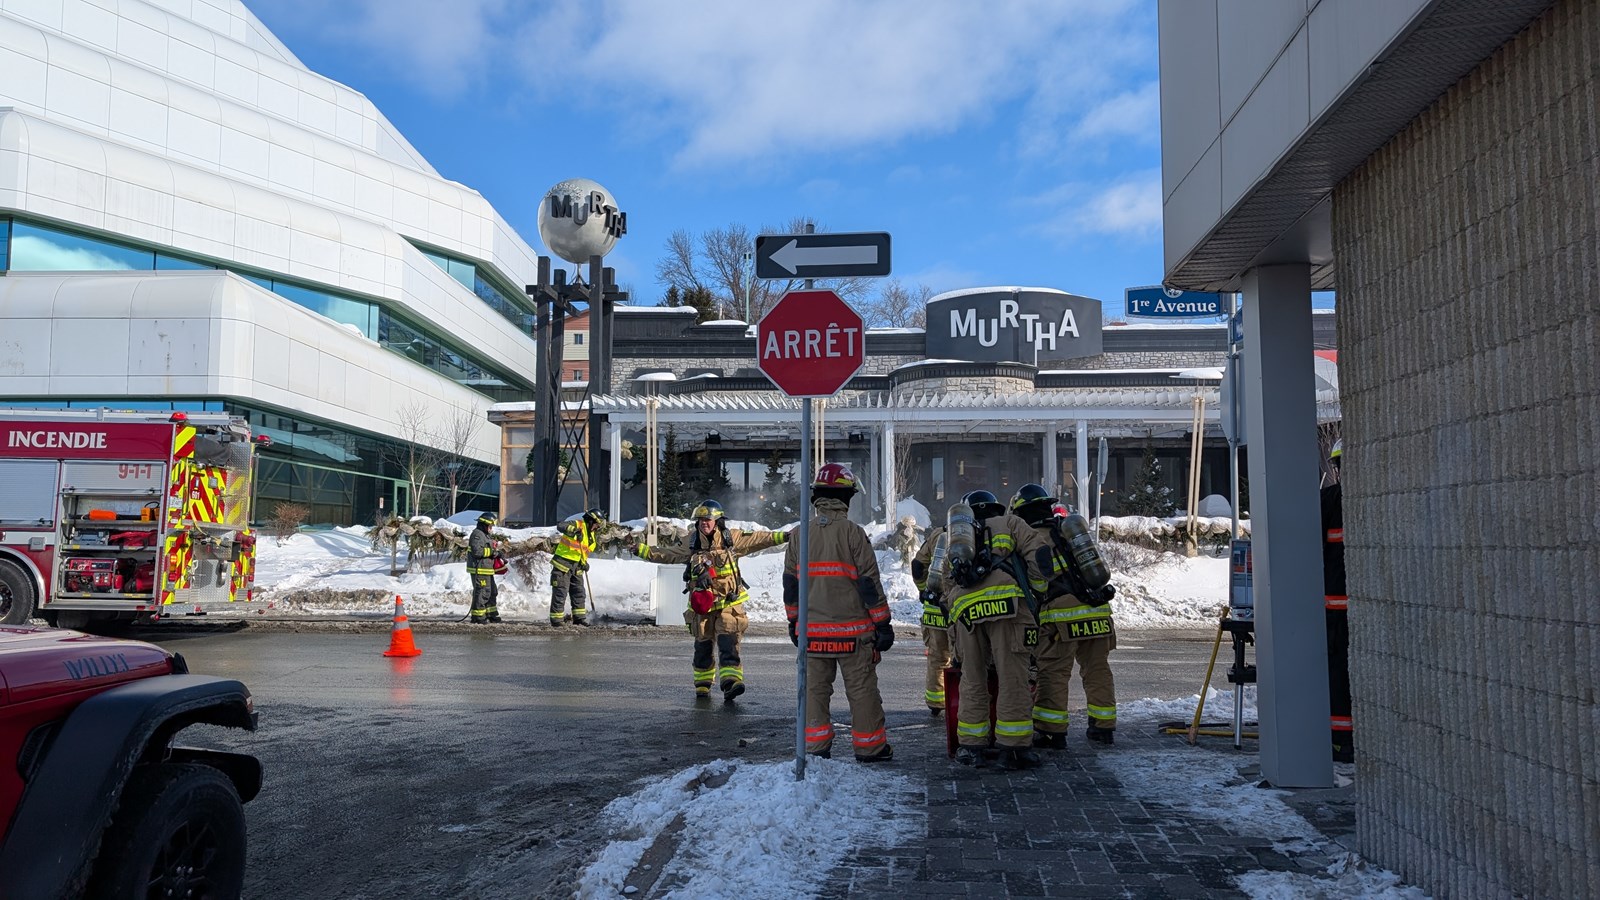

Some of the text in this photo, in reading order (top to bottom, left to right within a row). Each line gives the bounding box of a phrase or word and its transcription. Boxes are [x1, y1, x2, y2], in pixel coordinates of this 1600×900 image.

[1131, 298, 1217, 313] 1re Avenue
[950, 299, 1080, 351] MURTHA
[763, 322, 858, 360] ARRÊT
[8, 430, 108, 450] INCENDIE
[118, 463, 152, 480] 9-1-1
[969, 600, 1008, 620] EMOND
[1026, 630, 1037, 645] 33
